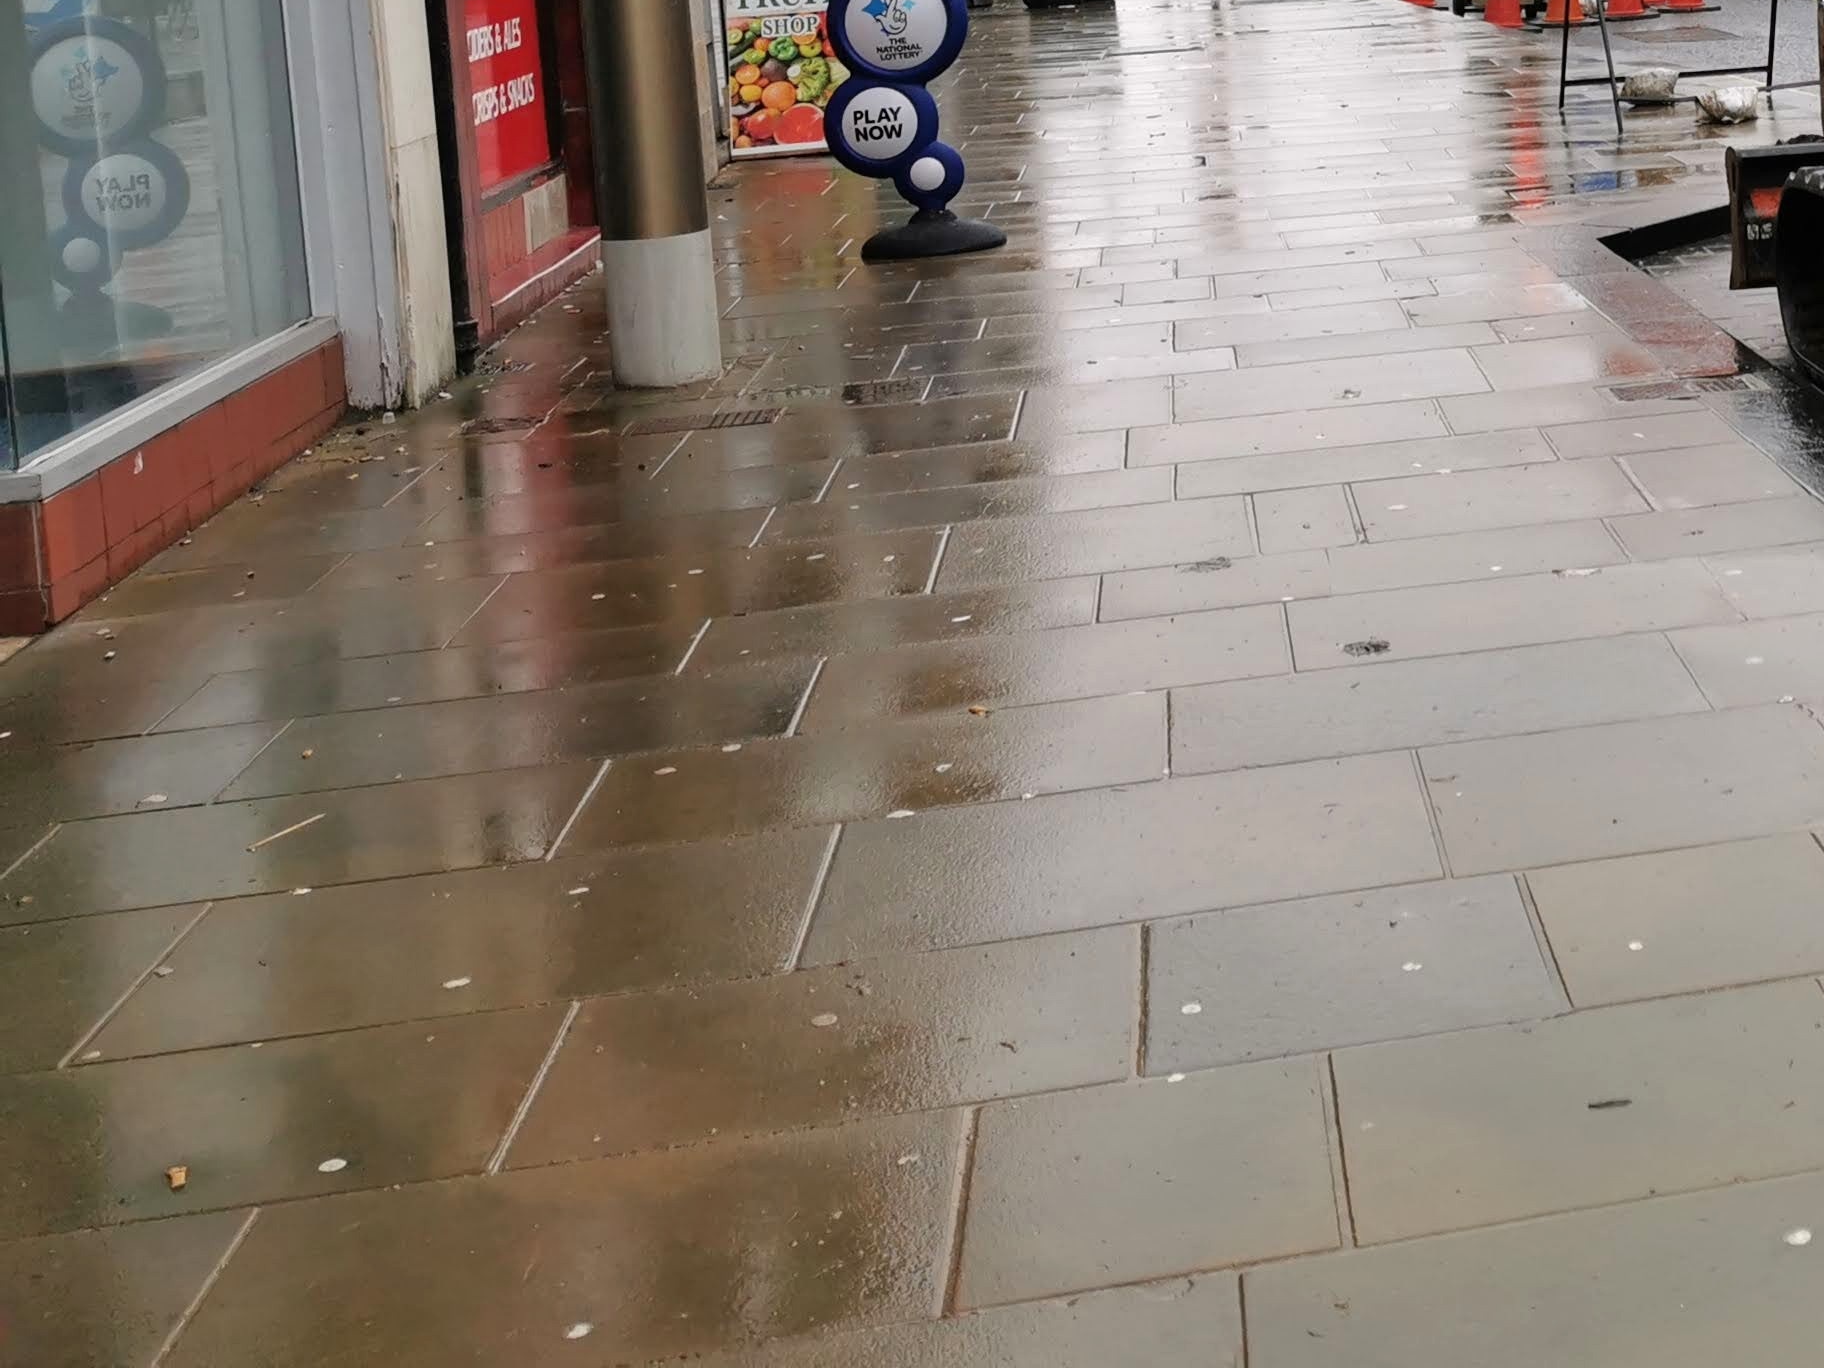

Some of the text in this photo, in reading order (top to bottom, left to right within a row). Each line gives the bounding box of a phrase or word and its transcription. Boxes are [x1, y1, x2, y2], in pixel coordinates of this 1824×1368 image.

[494, 22, 503, 54] &
[503, 16, 521, 51] ALES
[762, 16, 820, 36] SHOP
[876, 43, 923, 54] NATIONAL
[888, 37, 908, 46] THE
[879, 50, 922, 62] LOTTERY
[499, 83, 507, 115] &
[507, 72, 535, 112] SNACKS
[853, 106, 902, 126] PLAY
[854, 123, 903, 143] NOW
